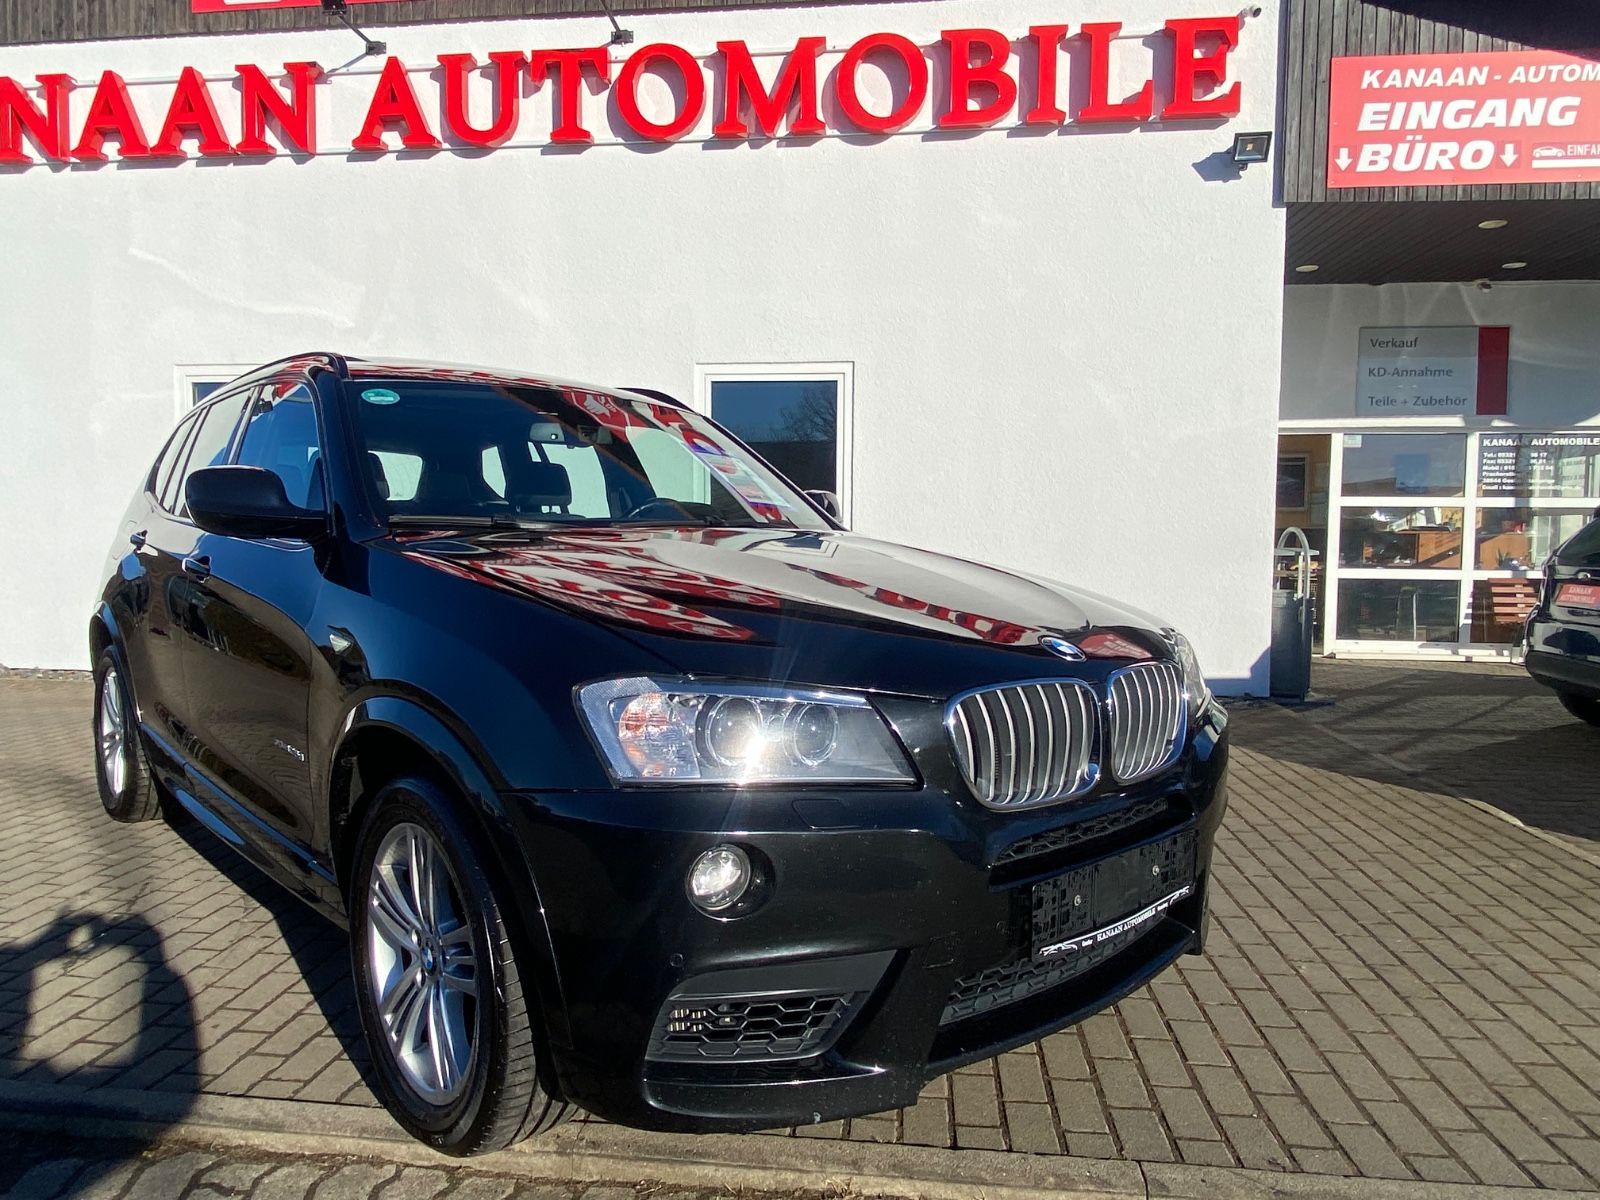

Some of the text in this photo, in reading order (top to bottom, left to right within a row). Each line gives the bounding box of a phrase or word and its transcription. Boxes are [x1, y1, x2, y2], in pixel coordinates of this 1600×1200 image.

[350, 16, 1242, 151] AUTOMOBILE
[1360, 66, 1490, 89] KANAAN
[1508, 63, 1600, 84] AUTOM
[1356, 96, 1582, 132] EINGANG
[1355, 134, 1496, 173] BÜRO
[1369, 336, 1419, 349] Verkauf
[1367, 366, 1454, 378] KD-Annahme
[1367, 396, 1397, 407] Teile
[1412, 395, 1468, 407] Zubehör
[1531, 437, 1600, 446] AUTOMOBILE
[1096, 924, 1123, 942] KANAAN
[1123, 907, 1156, 931] AUTOMOBILE
